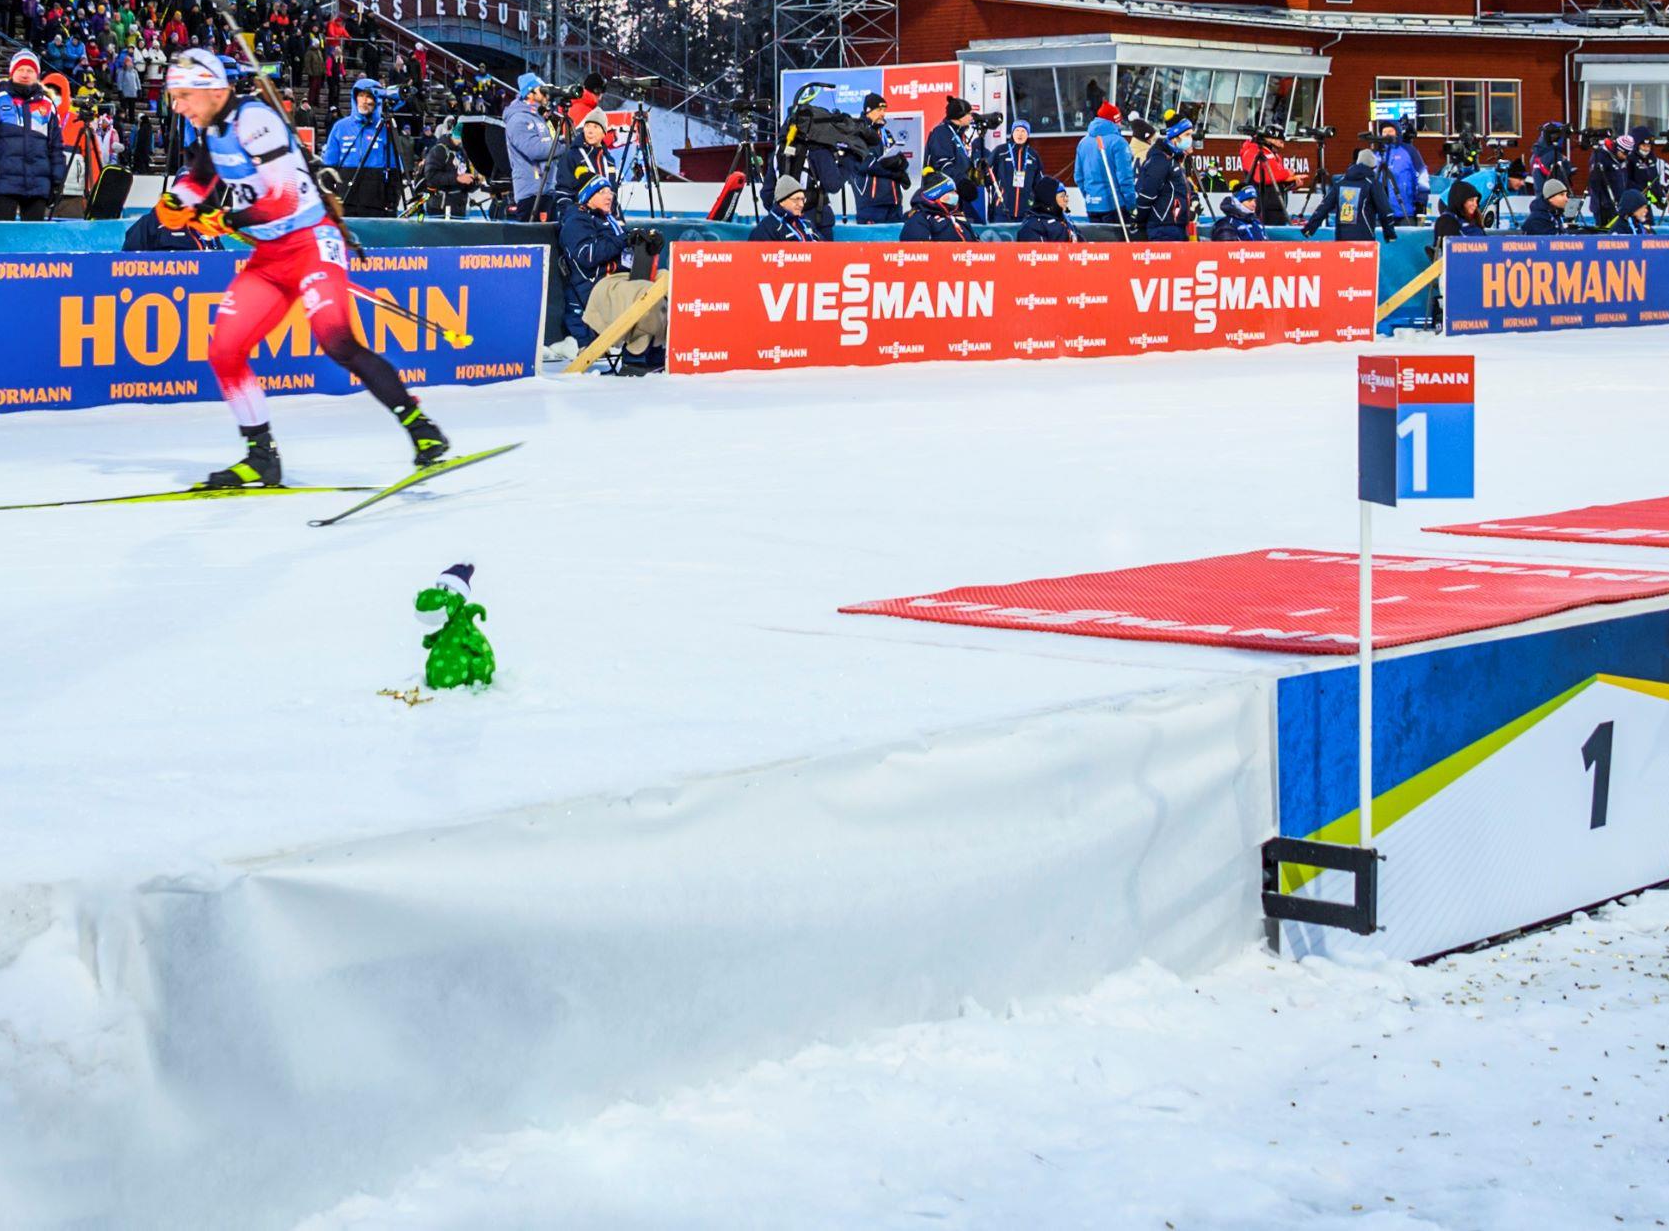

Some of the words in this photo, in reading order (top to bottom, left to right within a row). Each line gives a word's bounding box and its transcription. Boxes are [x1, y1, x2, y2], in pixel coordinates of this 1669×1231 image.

[890, 80, 953, 100] VIESSMANN
[1283, 157, 1310, 173] RENA
[112, 260, 199, 277] HÖRMANN
[460, 254, 532, 269] HÖRMANN
[680, 249, 732, 268] VIESSMANN
[762, 249, 811, 268] VIESSMANN
[883, 249, 929, 267] VIESSMANN
[952, 249, 995, 266] VIESSMANN
[1017, 249, 1059, 266] VIESSMANN
[1068, 249, 1110, 266] VIESSMANN
[1132, 249, 1171, 265] VIESSMANN
[1228, 248, 1266, 263] VIESSMANN
[1284, 248, 1321, 263] VIESSMANN
[1339, 248, 1373, 262] VIESSMANN
[1482, 258, 1647, 308] HÖRMANN
[677, 298, 730, 317] VIESSMANN
[1015, 294, 1057, 310] VIESSMANN
[1067, 293, 1108, 309] VIESSMANN
[1337, 286, 1372, 301] VIESSMANN
[759, 264, 994, 346] VIESSMANN
[1130, 261, 1321, 334] VIESSMANN
[676, 348, 729, 367] VIESSMANN
[757, 346, 807, 364] VIESSMANN
[878, 342, 924, 358] VIESSMANN
[948, 340, 991, 356] VIESSMANN
[1013, 338, 1056, 353] VIESSMANN
[1064, 336, 1107, 351] VIESSMANN
[1129, 334, 1169, 349] VIESSMANN
[1225, 329, 1265, 344] VIESSMANN
[1284, 328, 1319, 342] VIESSMANN
[1336, 325, 1371, 340] VIESSMANN
[111, 380, 198, 398] HÖRMANN
[256, 374, 315, 390] RMANN
[350, 369, 427, 386] HANN
[456, 363, 523, 380] HÖRMANN
[1360, 369, 1395, 393] VIESSMANN
[1397, 368, 1469, 392] ESSMANN
[1396, 412, 1428, 492] 1
[1581, 720, 1614, 830] 1
